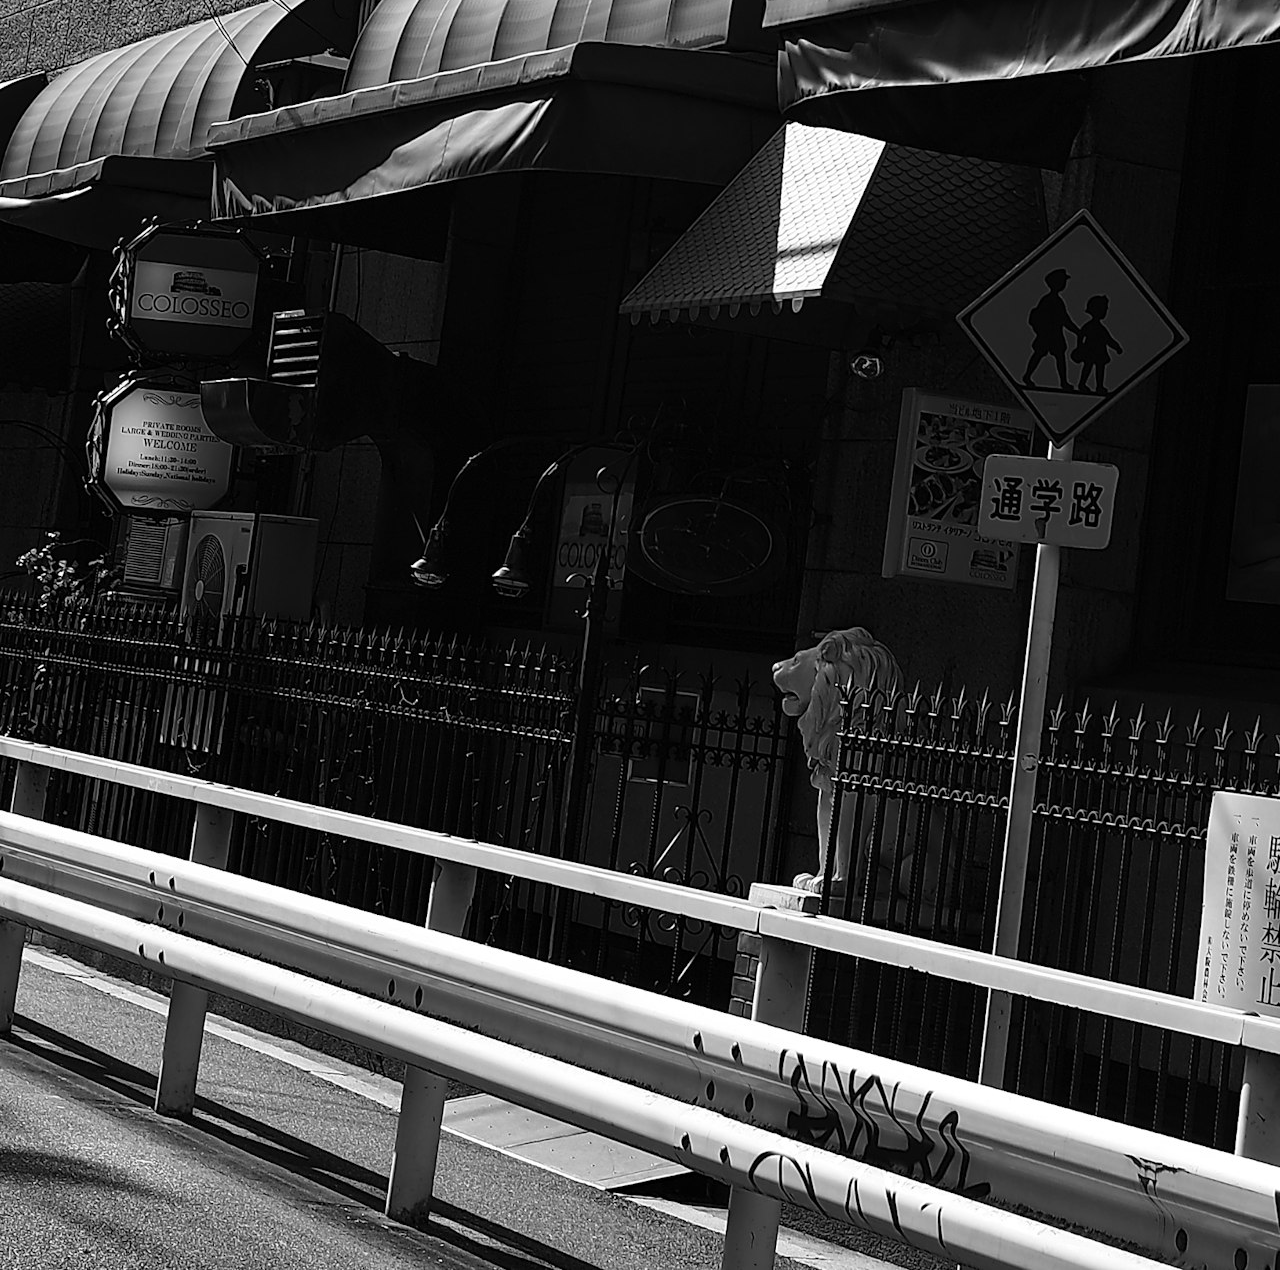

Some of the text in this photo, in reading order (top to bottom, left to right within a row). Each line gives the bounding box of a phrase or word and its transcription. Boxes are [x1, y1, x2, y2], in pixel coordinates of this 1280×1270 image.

[138, 293, 250, 319] COLOSSEO
[121, 426, 146, 436] LARGE
[155, 430, 188, 440] WEDDING
[189, 433, 221, 443] PARTIES
[142, 421, 202, 433] PRIVATE ROOMS
[143, 438, 198, 453] WELCOME
[990, 477, 1104, 528] 通学路
